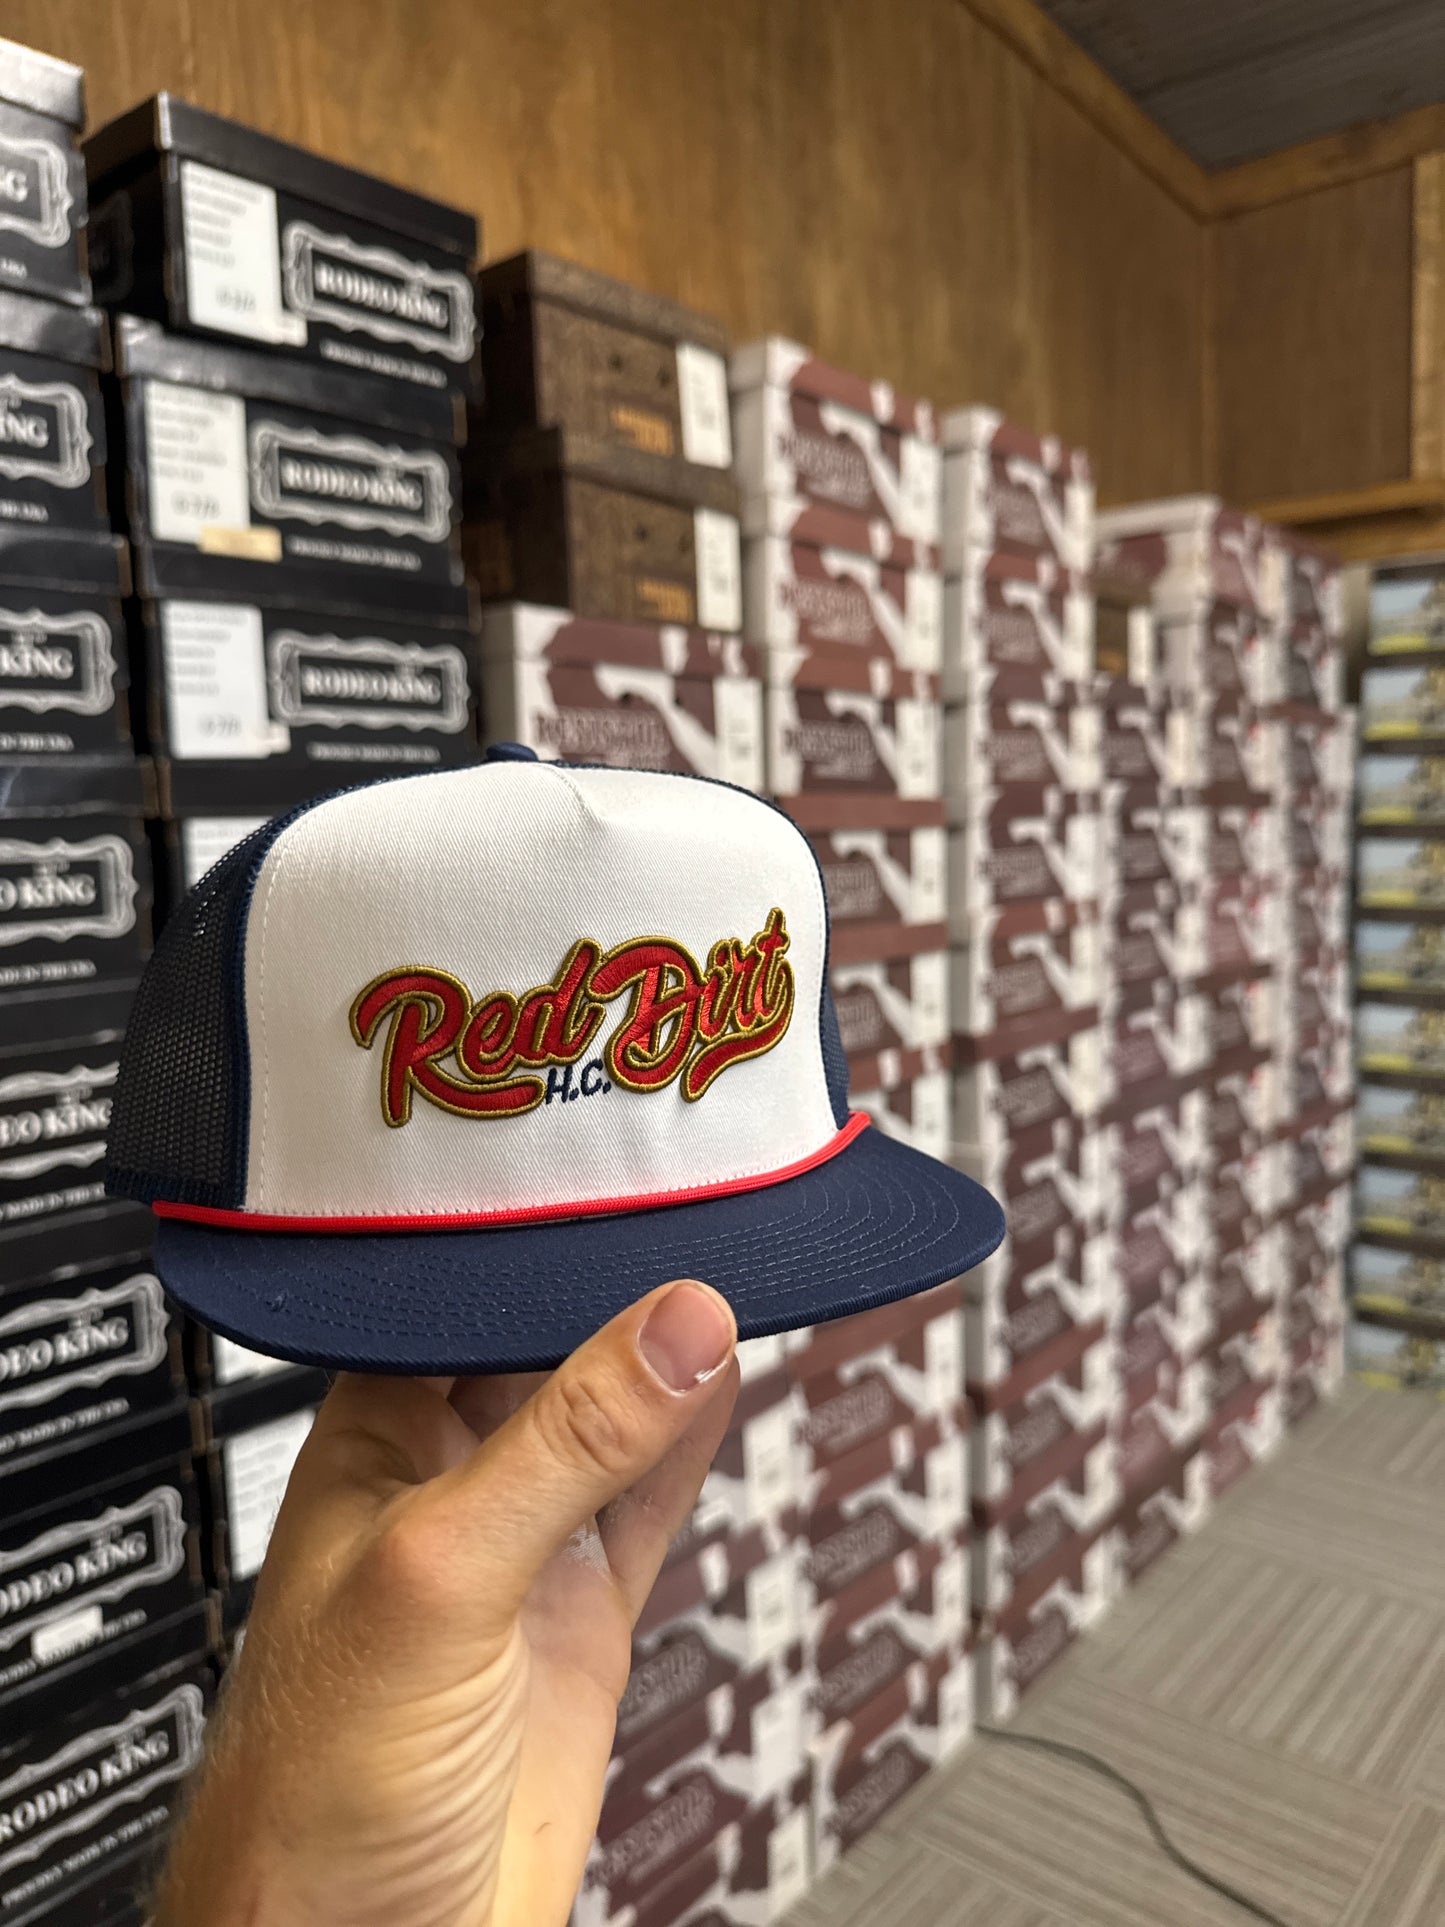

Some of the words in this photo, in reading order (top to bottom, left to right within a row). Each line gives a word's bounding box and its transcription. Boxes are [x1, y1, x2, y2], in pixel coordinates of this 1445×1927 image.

[18, 872, 96, 909] KING
[349, 937, 605, 1127] Red
[588, 907, 795, 1103] Dirt
[545, 1058, 612, 1104] H.C.
[53, 1316, 129, 1365] KING
[75, 1531, 147, 1583] KING
[100, 1730, 170, 1786] KING
